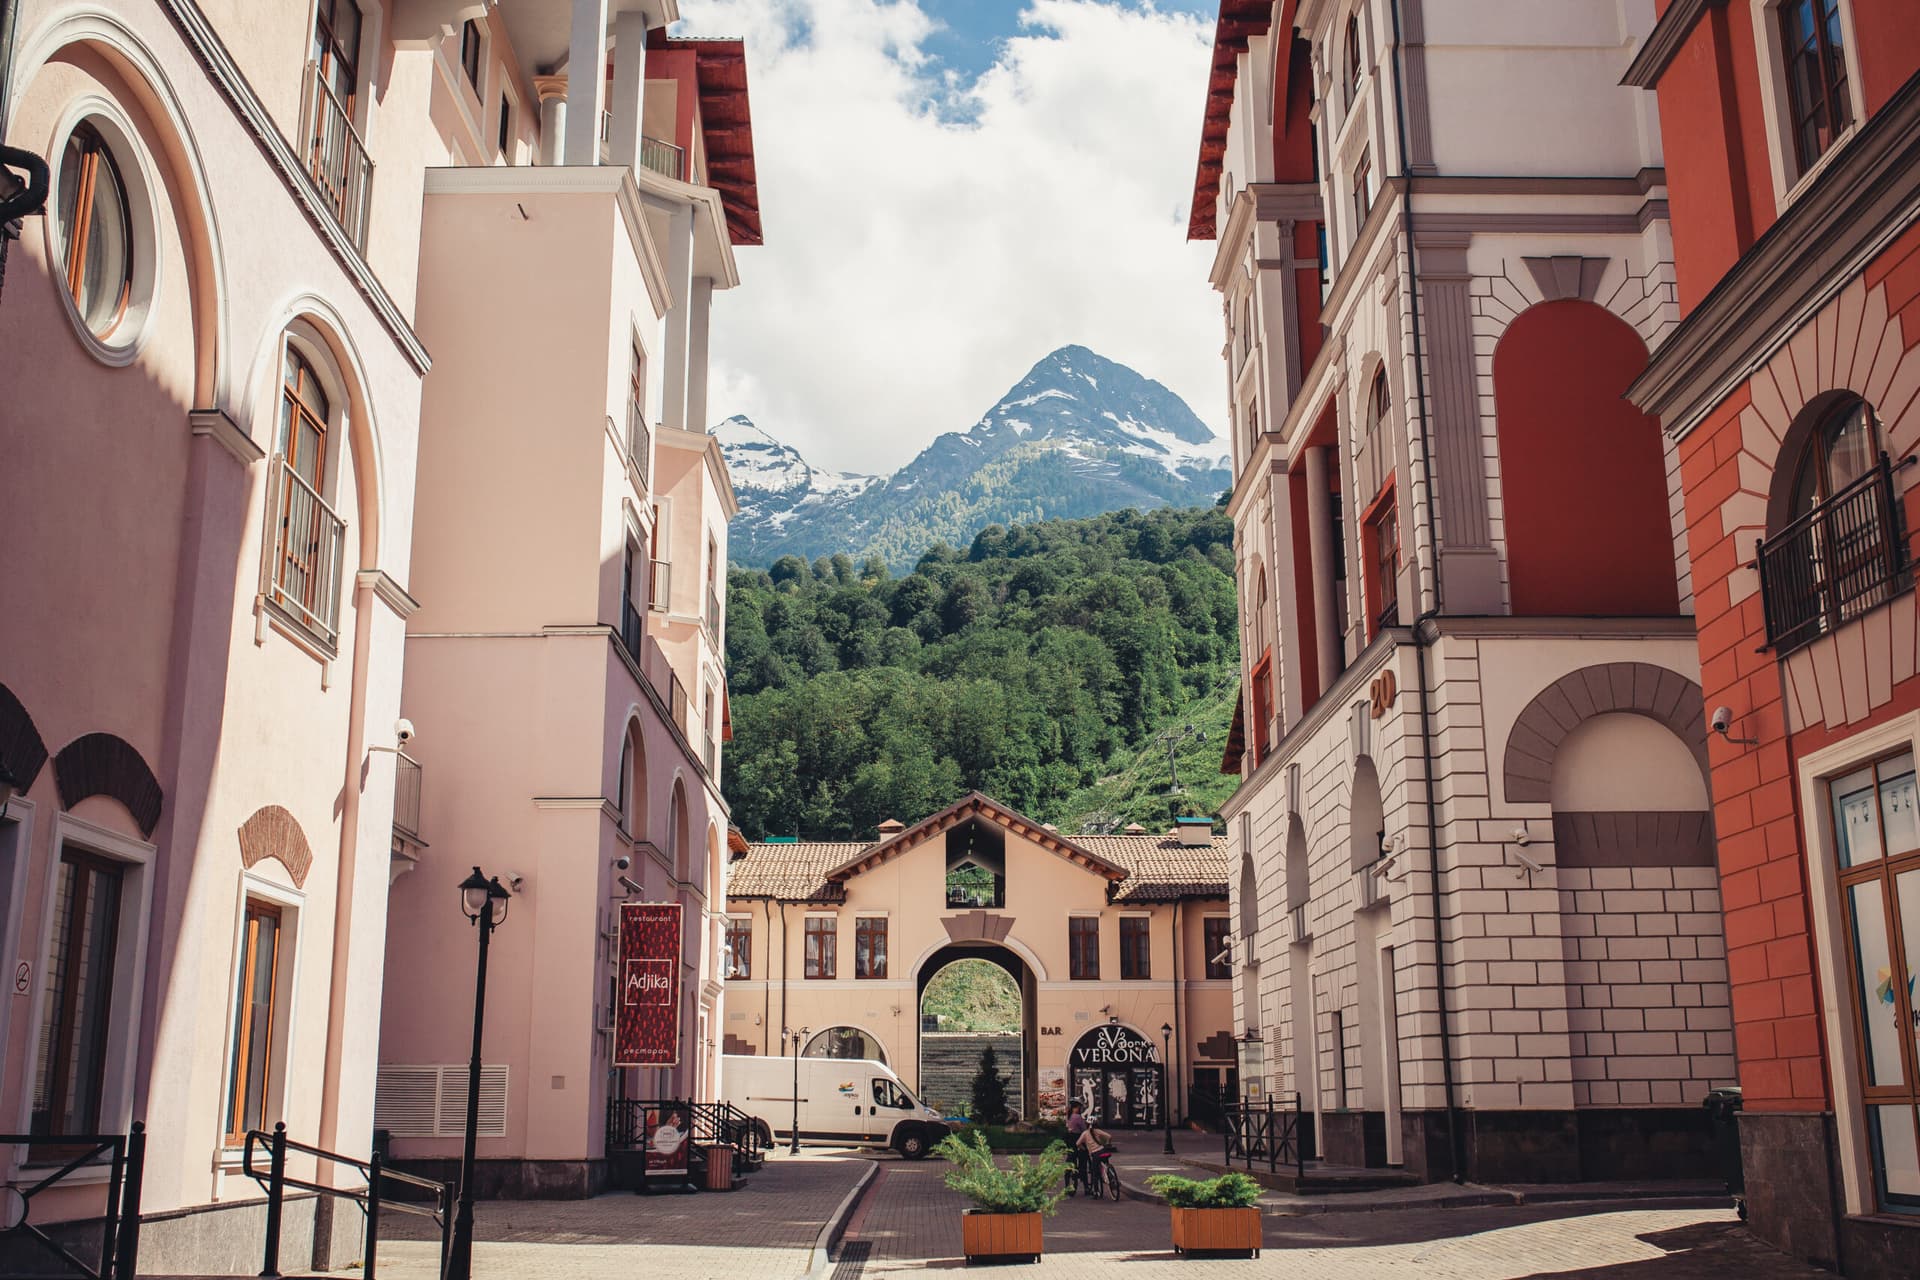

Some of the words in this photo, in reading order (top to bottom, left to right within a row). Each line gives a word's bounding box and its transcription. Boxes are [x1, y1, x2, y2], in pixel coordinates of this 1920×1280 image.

[1370, 669, 1396, 719] 20
[628, 973, 669, 992] Adjika
[1041, 1027, 1062, 1036] BAR
[1077, 1048, 1155, 1063] VERONA
